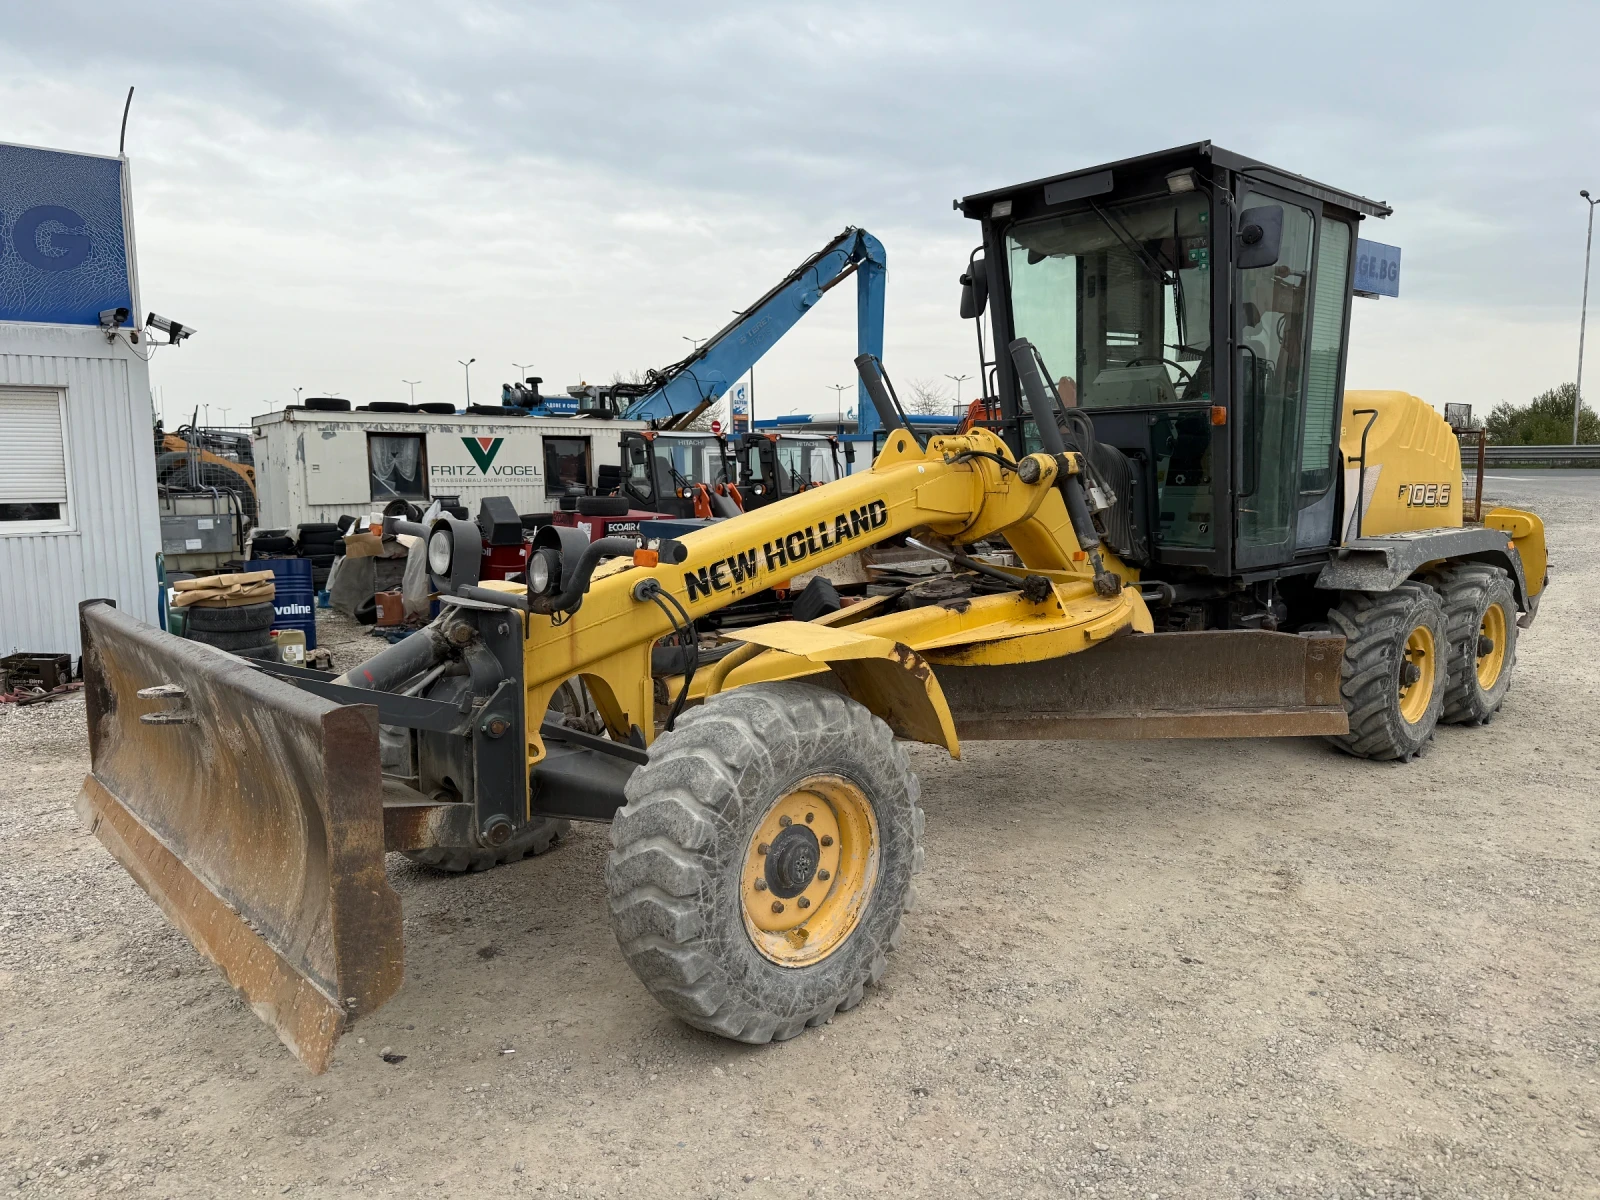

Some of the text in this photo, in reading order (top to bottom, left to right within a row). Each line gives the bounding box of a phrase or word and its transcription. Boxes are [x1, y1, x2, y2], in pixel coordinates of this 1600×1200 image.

[431, 465, 542, 476] FRITZ VOGEL
[608, 522, 636, 532] ECOAIR
[683, 498, 889, 603] NEW HOLLAND
[273, 603, 312, 616] voline
